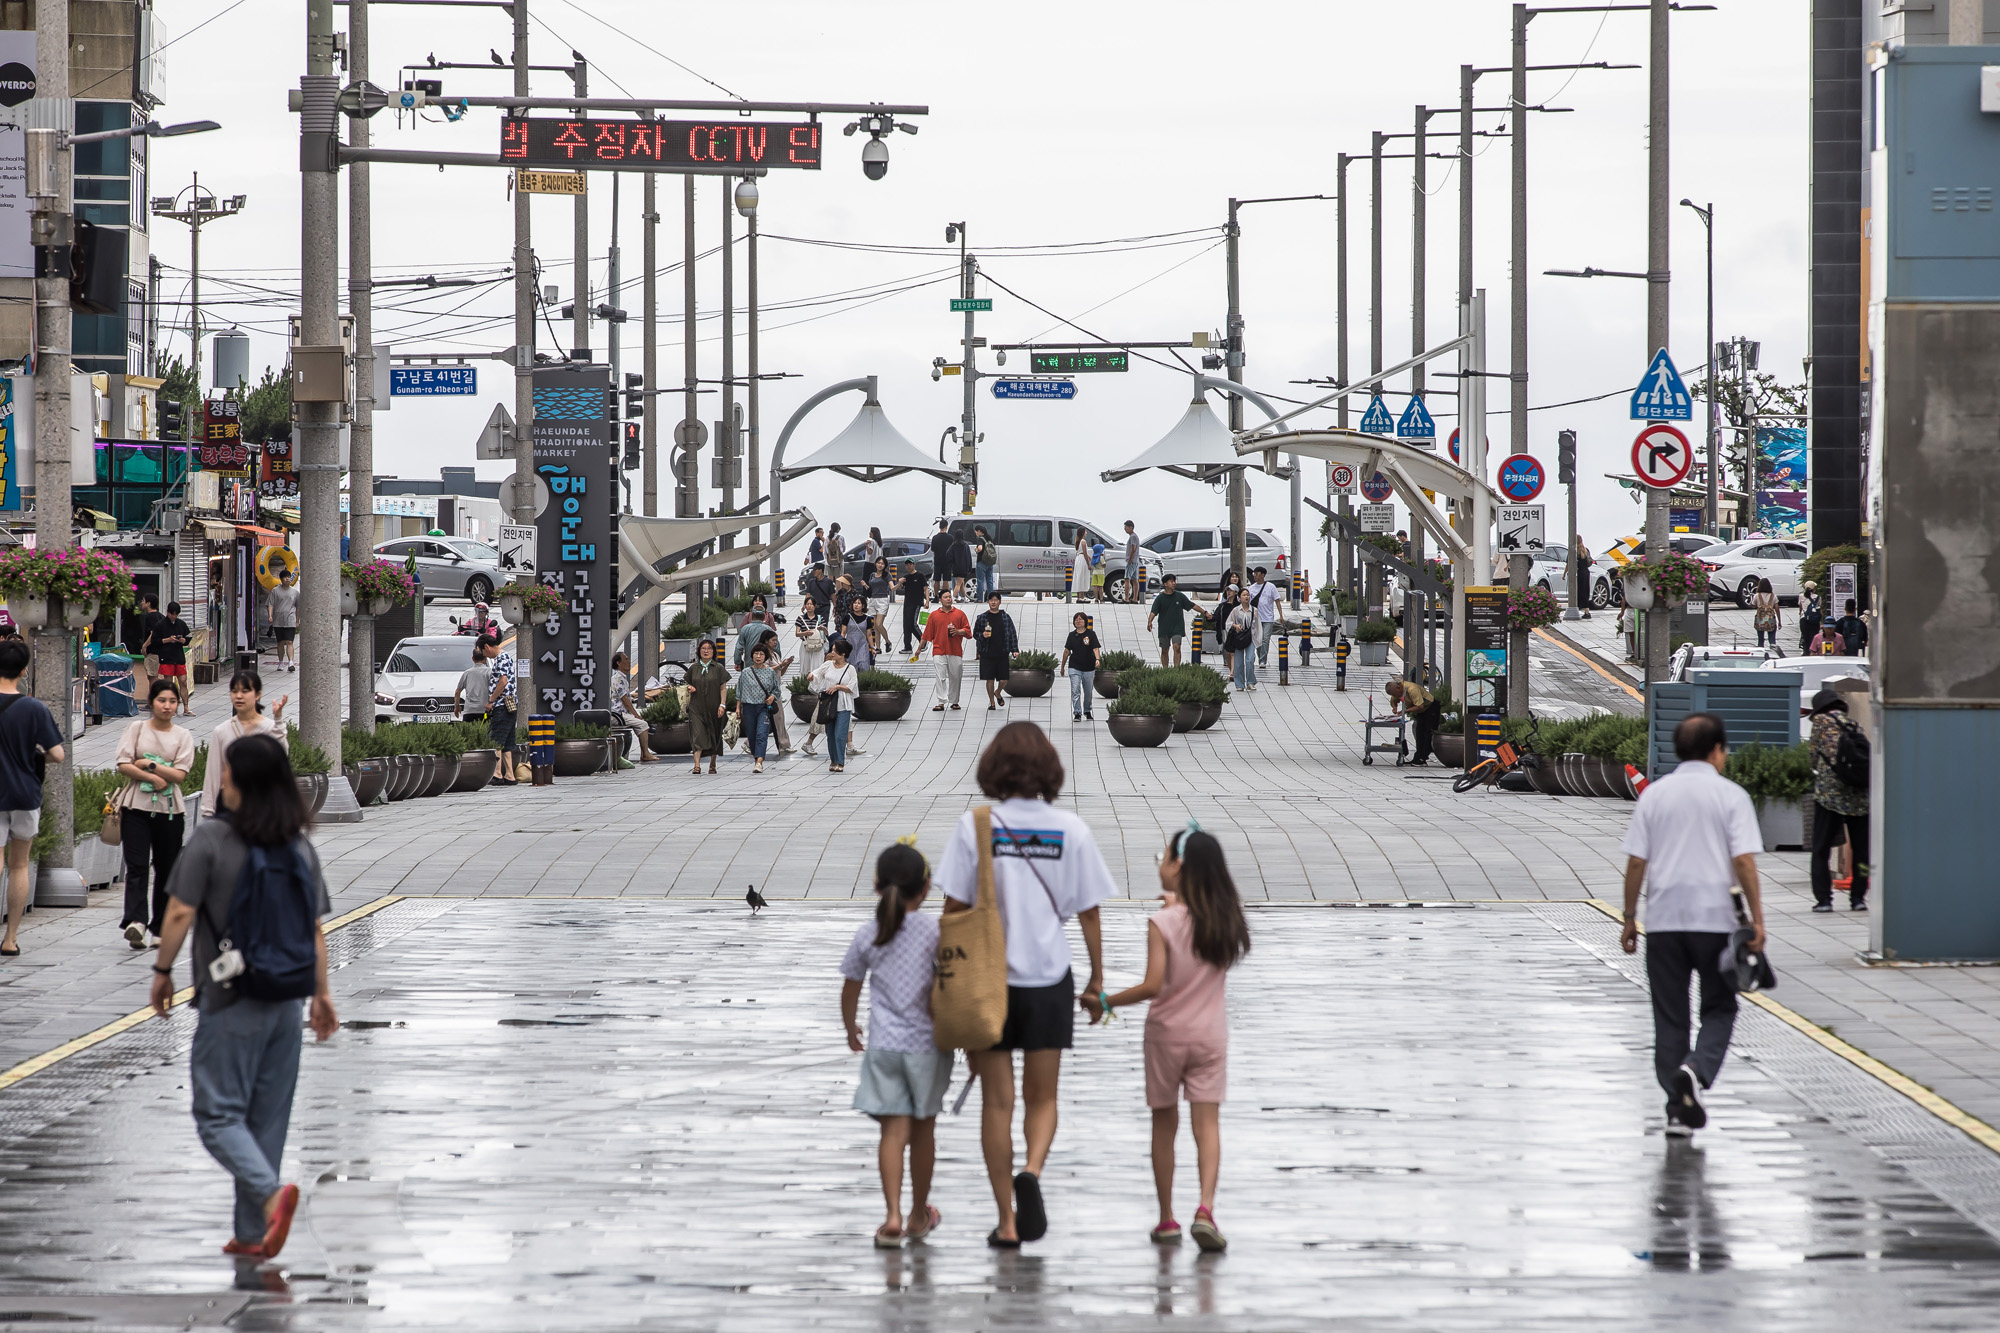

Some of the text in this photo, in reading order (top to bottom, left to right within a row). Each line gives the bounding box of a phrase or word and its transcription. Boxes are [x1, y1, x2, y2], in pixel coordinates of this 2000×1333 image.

[0, 80, 36, 90] VERDO
[553, 122, 666, 160] 주정차
[689, 126, 767, 162] CCTV
[395, 370, 473, 384] 구남로 41번길
[396, 385, 474, 394] Gunam-ro 41beon-gil
[1009, 382, 1059, 392] 해운대해변로
[210, 401, 239, 417] 정통
[1637, 406, 1688, 418] 횡단보도
[209, 423, 240, 439] 王家
[533, 427, 591, 436] HAEUNDAE
[266, 441, 289, 455] 정통
[533, 438, 604, 447] TRADITIONAL
[201, 444, 248, 466] 탕후루
[533, 449, 577, 457] MARKET
[1336, 470, 1349, 482] 30
[1504, 473, 1539, 483] 주정차금지
[262, 477, 298, 496] 탕후루
[538, 465, 596, 561] 해운대
[1502, 510, 1540, 521] 견인지역
[503, 529, 533, 541] 견인지역
[571, 570, 597, 710] 구남로광장
